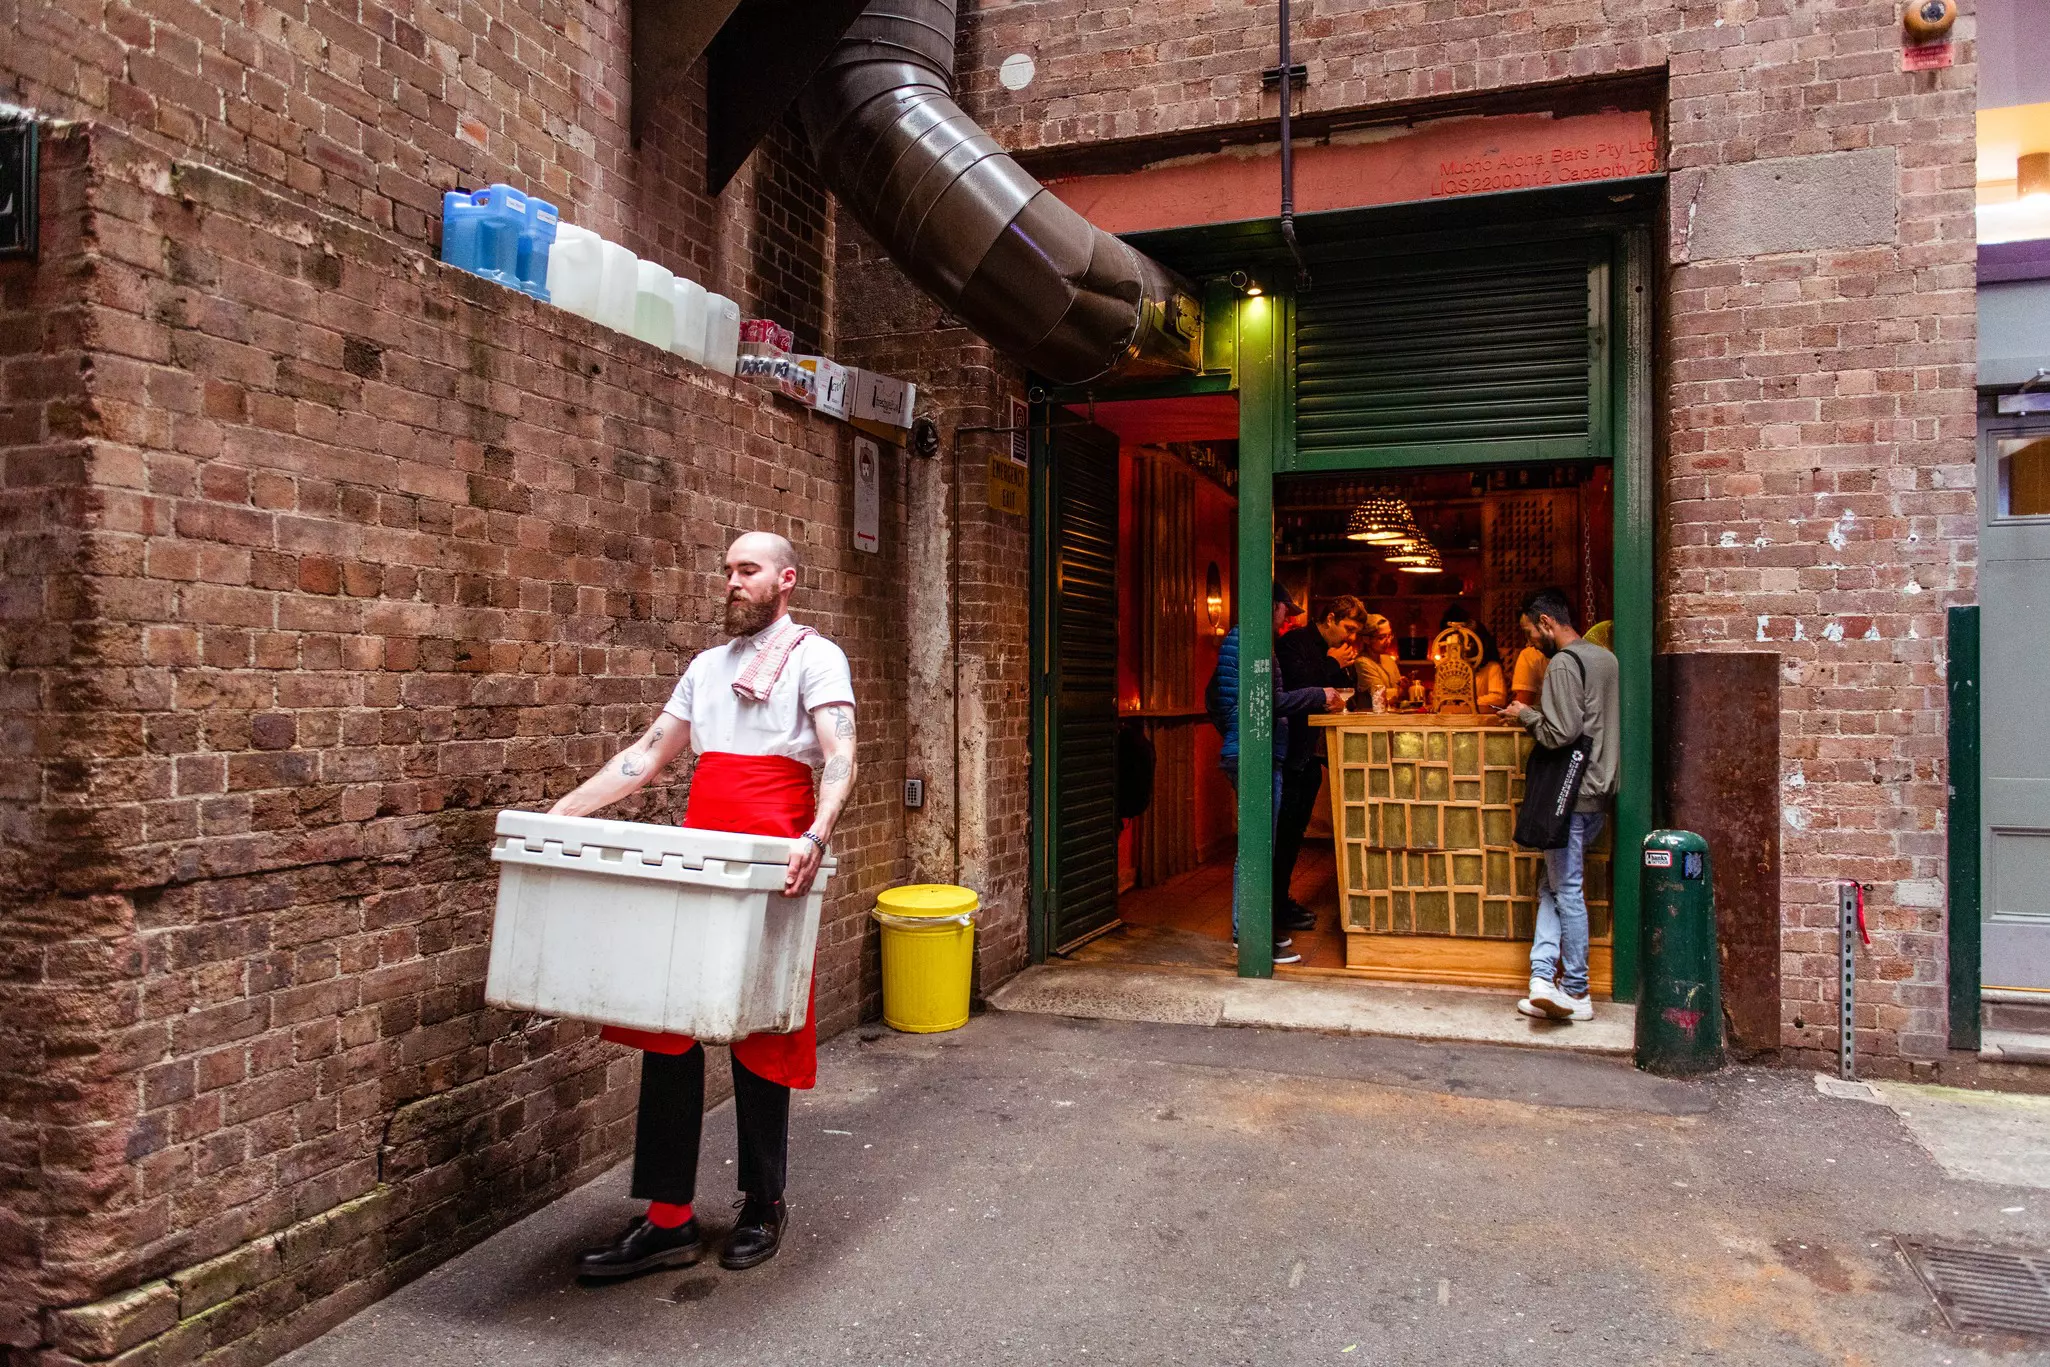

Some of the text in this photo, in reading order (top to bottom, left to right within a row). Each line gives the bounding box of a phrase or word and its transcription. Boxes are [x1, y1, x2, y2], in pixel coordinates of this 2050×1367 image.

[1551, 148, 1589, 163] Bars
[1596, 143, 1624, 159] Pty
[1629, 136, 1658, 154] Ltd
[1558, 163, 1632, 182] Capacity
[992, 459, 1025, 488] EMERGENCY
[1002, 489, 1016, 509] EXIT
